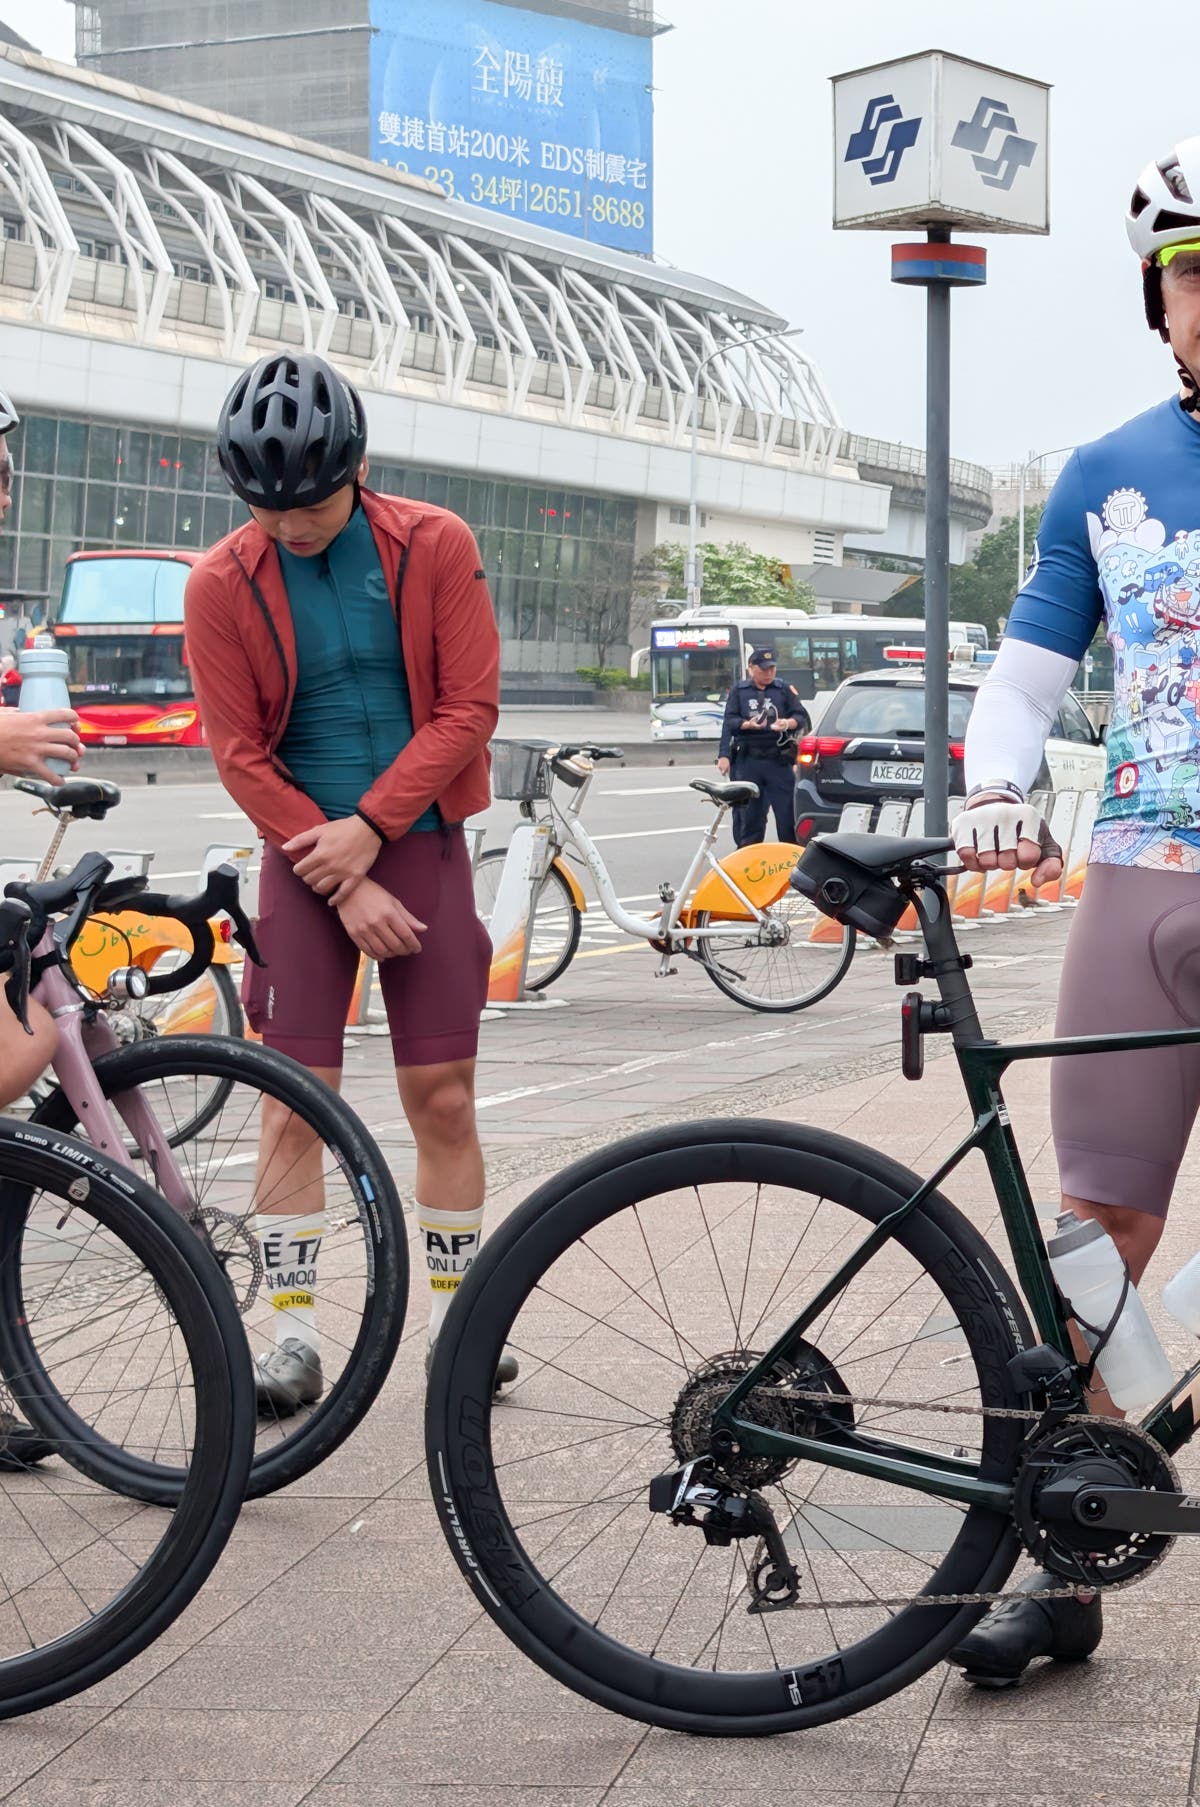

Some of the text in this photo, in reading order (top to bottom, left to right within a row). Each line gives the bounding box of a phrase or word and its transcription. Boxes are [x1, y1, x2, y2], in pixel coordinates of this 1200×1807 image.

[378, 111, 648, 190] 雙捷首站200米 EDS制震宅
[872, 765, 922, 781] AXE-6022
[24, 1133, 48, 1146] DURO
[52, 1141, 93, 1166] LIMIT
[443, 1496, 478, 1568] PIRELLI
